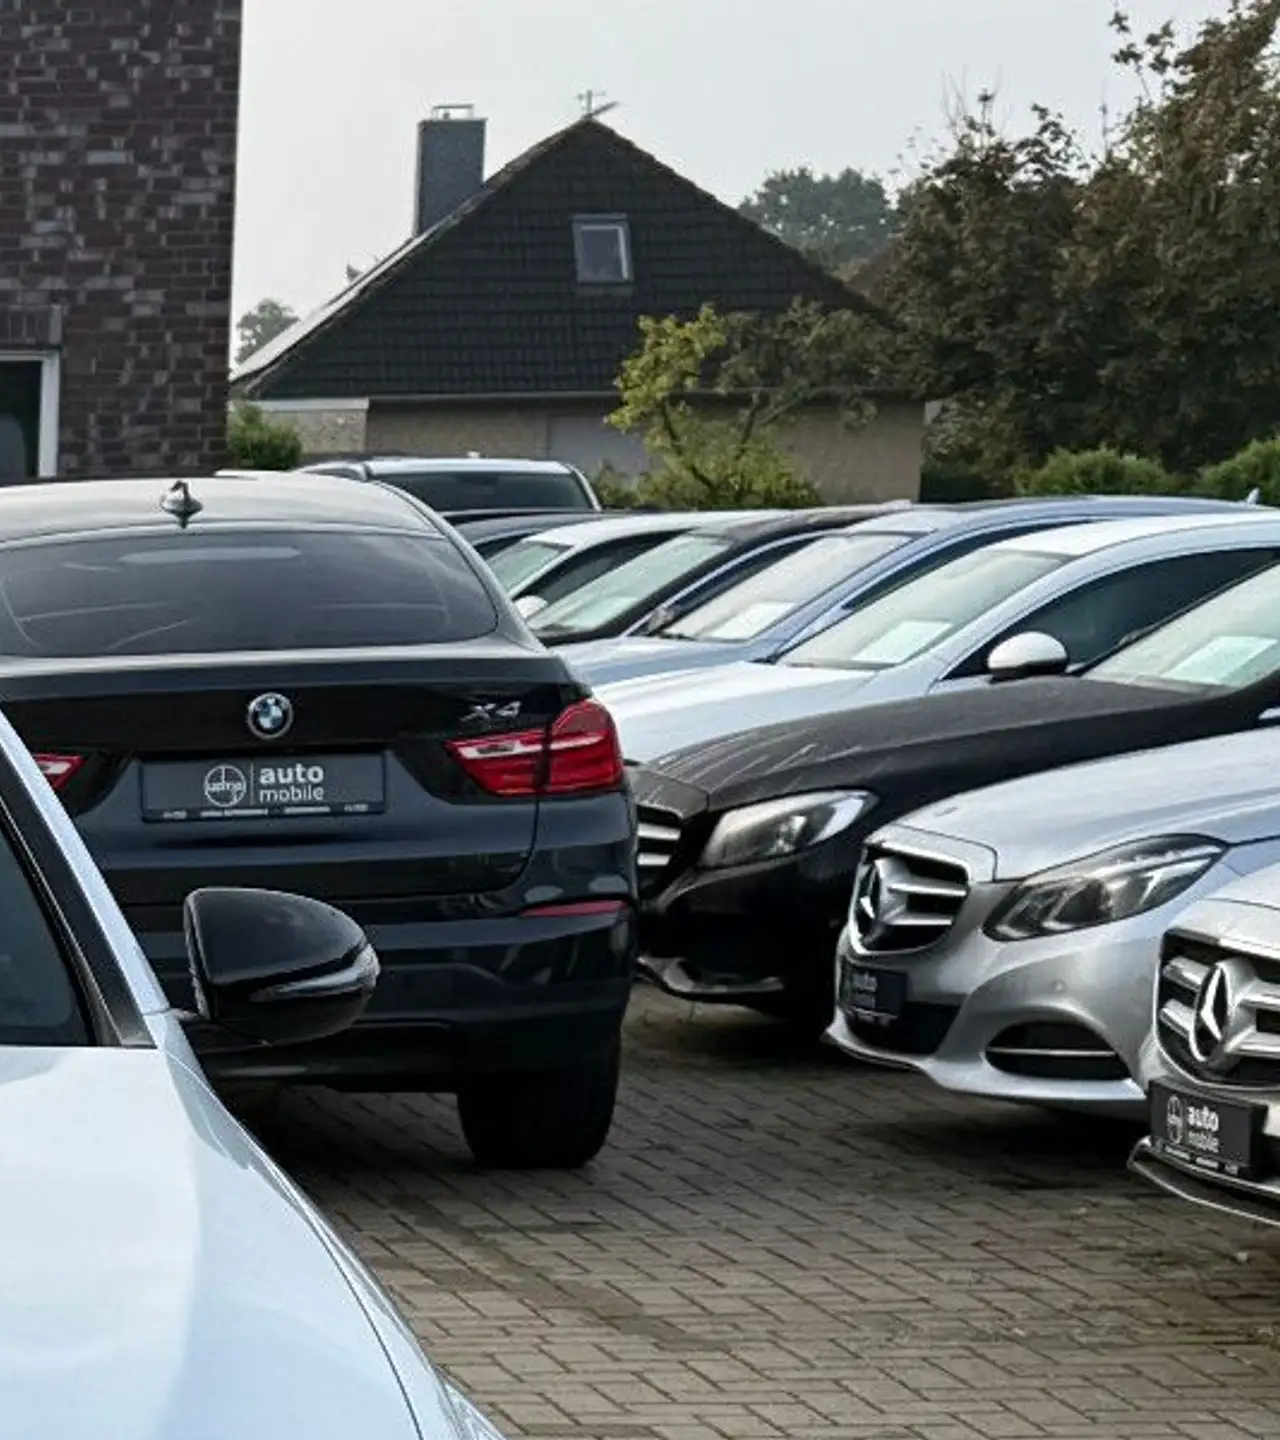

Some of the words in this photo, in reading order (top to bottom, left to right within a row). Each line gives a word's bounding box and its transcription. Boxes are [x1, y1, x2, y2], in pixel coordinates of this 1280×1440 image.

[460, 700, 522, 722] X4
[259, 763, 324, 784] auto
[260, 784, 324, 803] mobile
